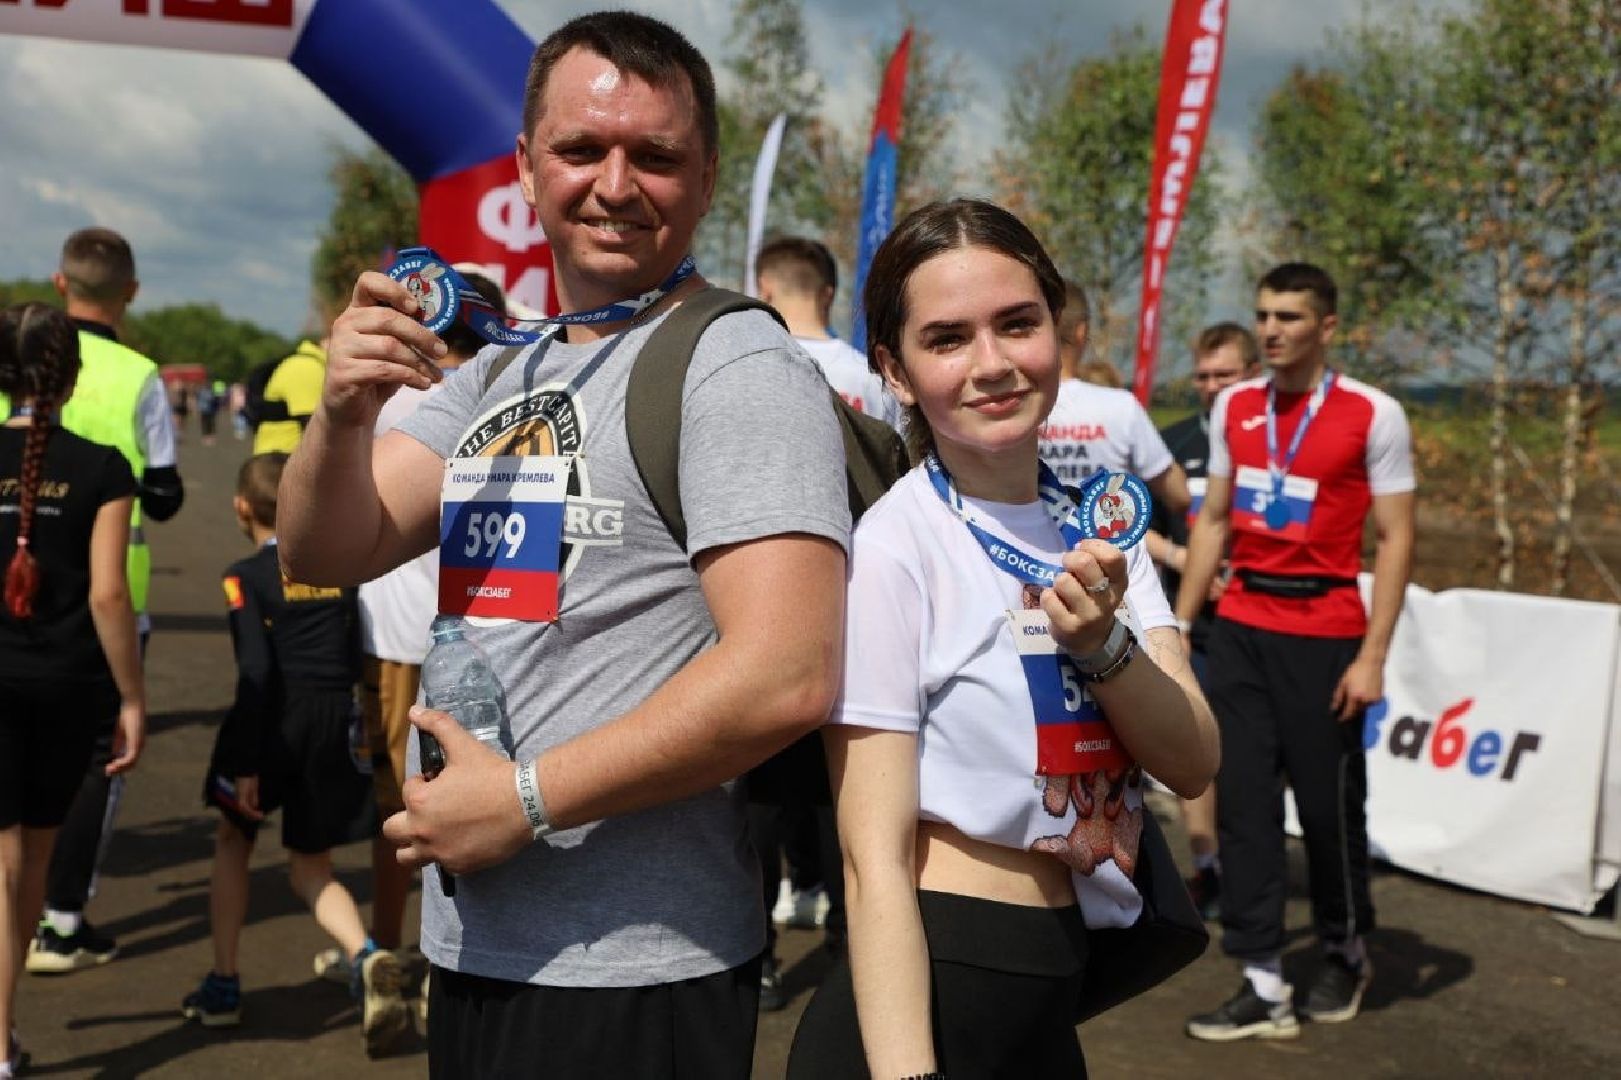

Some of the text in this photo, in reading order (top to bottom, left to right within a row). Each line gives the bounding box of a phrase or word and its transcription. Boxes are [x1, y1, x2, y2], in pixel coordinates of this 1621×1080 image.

[501, 395, 551, 428] BEST
[452, 472, 486, 484] КОМАНДА
[463, 511, 526, 559] 599
